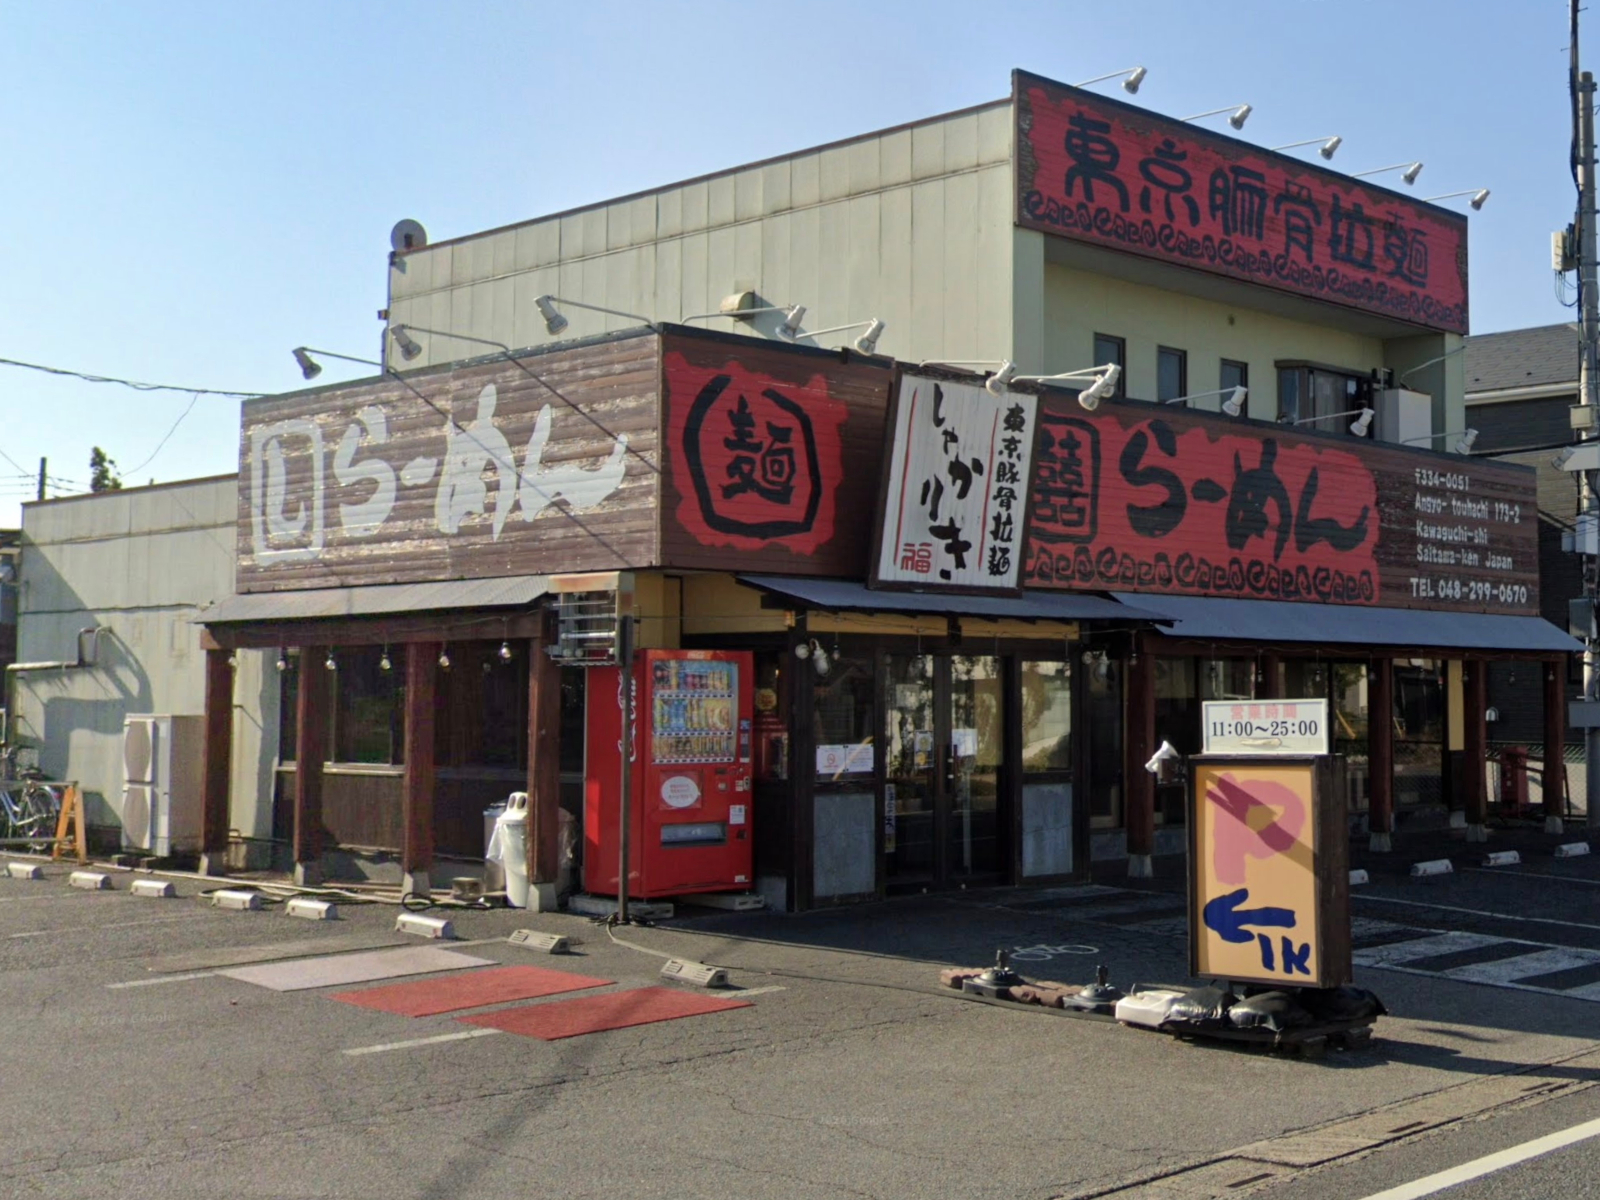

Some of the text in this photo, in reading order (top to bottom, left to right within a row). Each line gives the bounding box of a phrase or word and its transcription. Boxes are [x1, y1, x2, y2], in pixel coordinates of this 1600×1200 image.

[919, 382, 984, 581] しゃかりき
[1118, 418, 1370, 563] らーめん
[1494, 502, 1521, 524] 173-2
[1416, 519, 1488, 545] Kawaguchi-shi
[1416, 544, 1513, 570] Saitama-ken Japan
[1438, 579, 1528, 604] 048-299-0670
[1230, 703, 1298, 720] 営業時間
[1208, 772, 1306, 885] P
